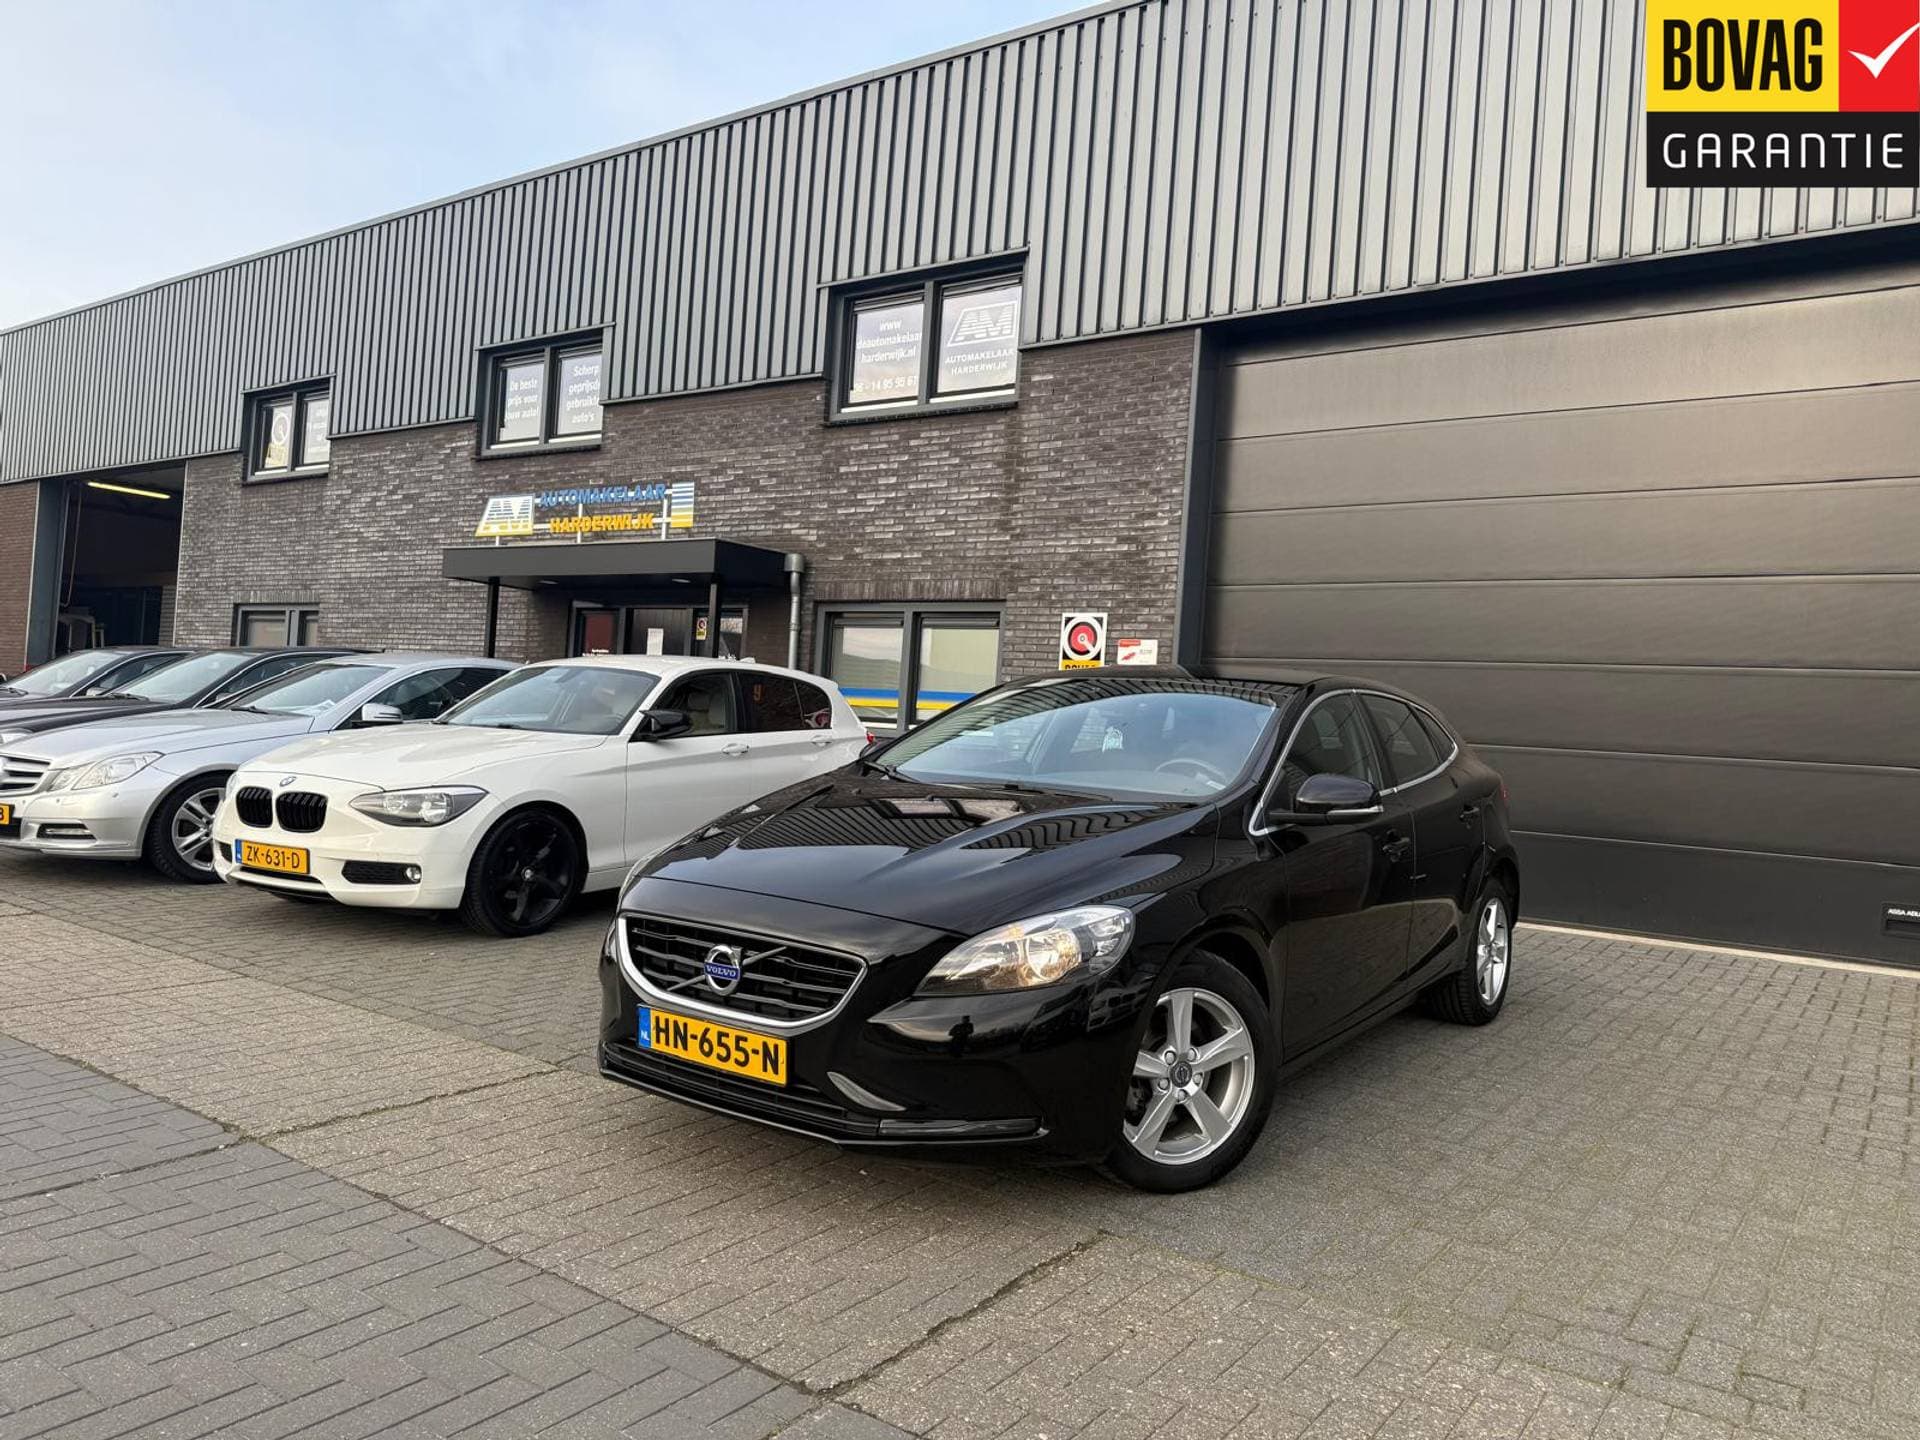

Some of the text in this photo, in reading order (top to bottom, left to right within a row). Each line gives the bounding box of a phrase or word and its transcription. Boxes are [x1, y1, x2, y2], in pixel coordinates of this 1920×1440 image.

[945, 349, 1015, 364] AUTOMAKELAAR
[951, 361, 1008, 376] HARDERWIJK
[538, 484, 666, 508] AUTOMAKELAAR
[550, 512, 654, 534] HARDERWIJK
[246, 846, 300, 869] ZK-631-D
[705, 964, 737, 978] VOLVO
[640, 1015, 779, 1075] NL HN-655-N
